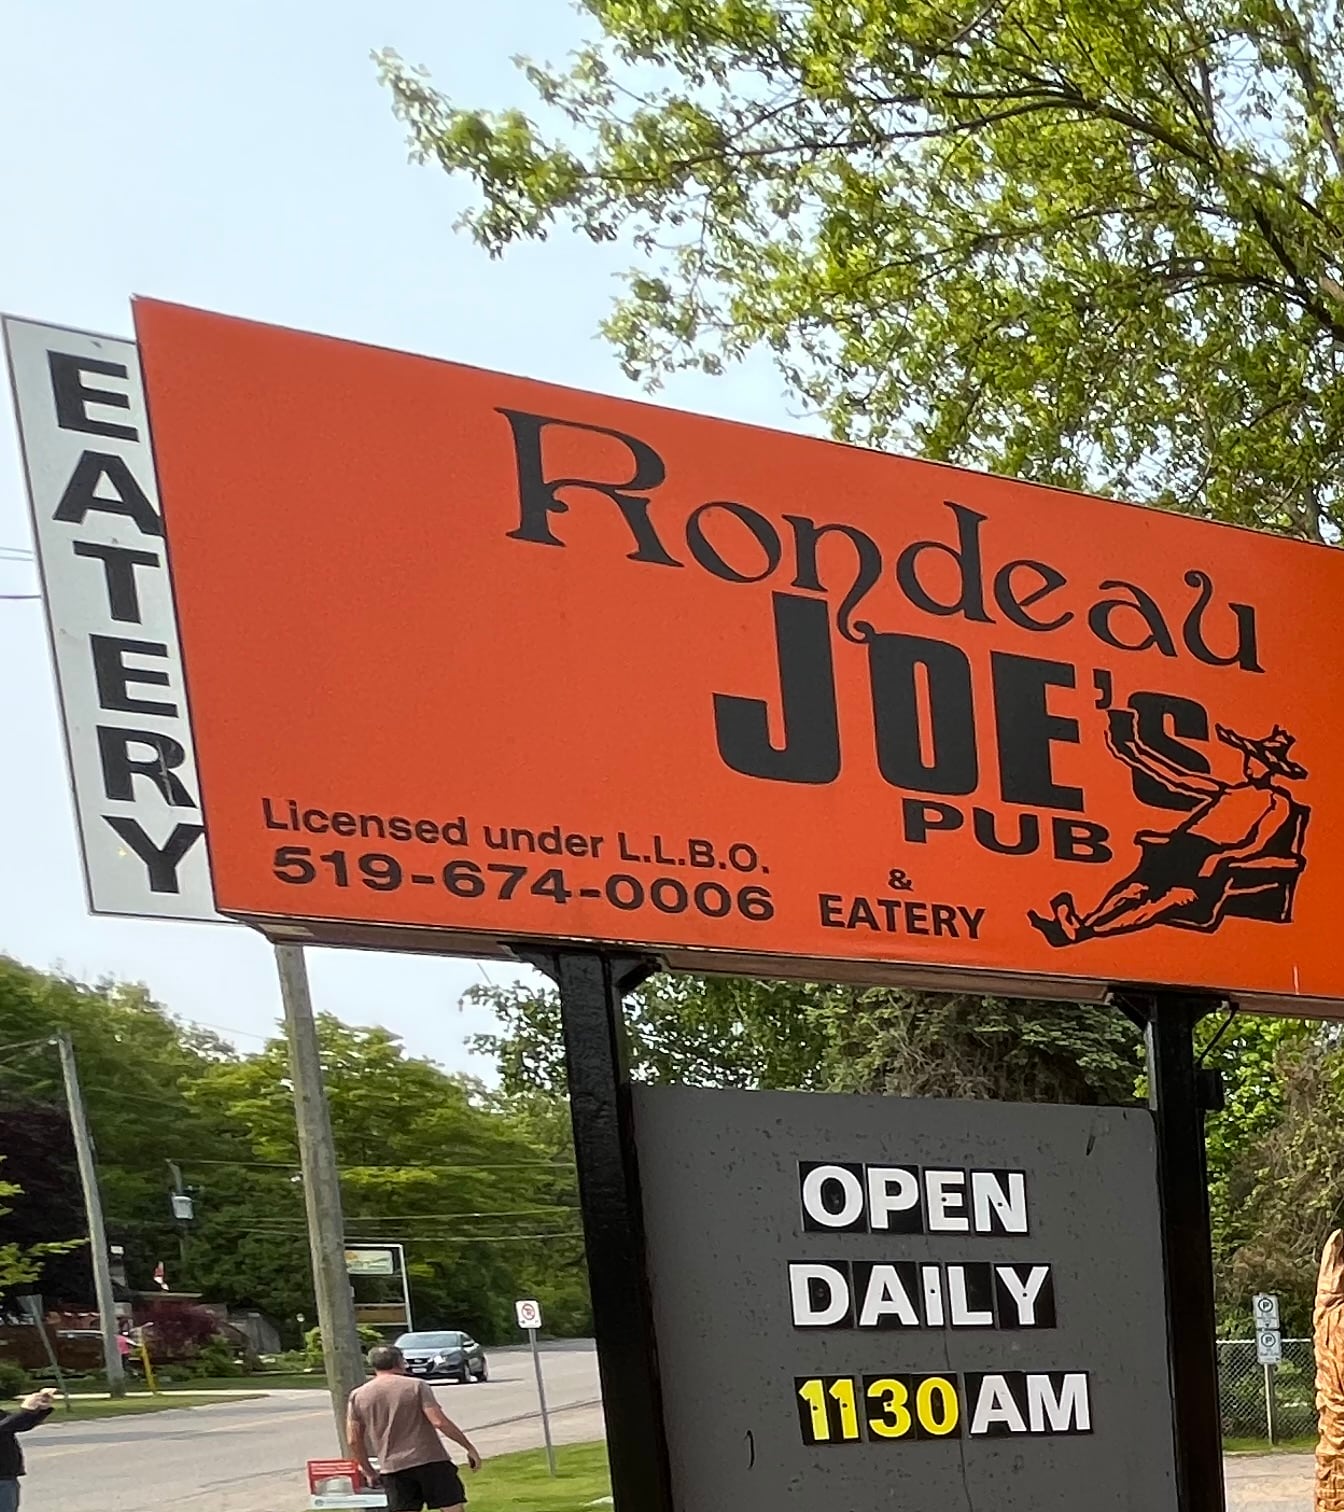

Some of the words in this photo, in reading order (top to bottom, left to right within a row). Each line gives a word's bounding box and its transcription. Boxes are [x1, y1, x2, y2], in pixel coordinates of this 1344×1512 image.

[494, 406, 1265, 674] Rondeau
[46, 349, 205, 894] EATERY
[712, 591, 1212, 812] JOE'S
[261, 797, 467, 847] Licensed
[484, 825, 604, 858] under
[617, 832, 771, 874] L.L.B.O.
[902, 797, 1113, 863] PUB
[272, 846, 775, 921] 519-674-0006
[888, 867, 913, 892] &
[818, 894, 987, 940] EATERY
[802, 1164, 1028, 1233] OPEN
[788, 1263, 1049, 1327] DAILY
[970, 1373, 1091, 1434] AM
